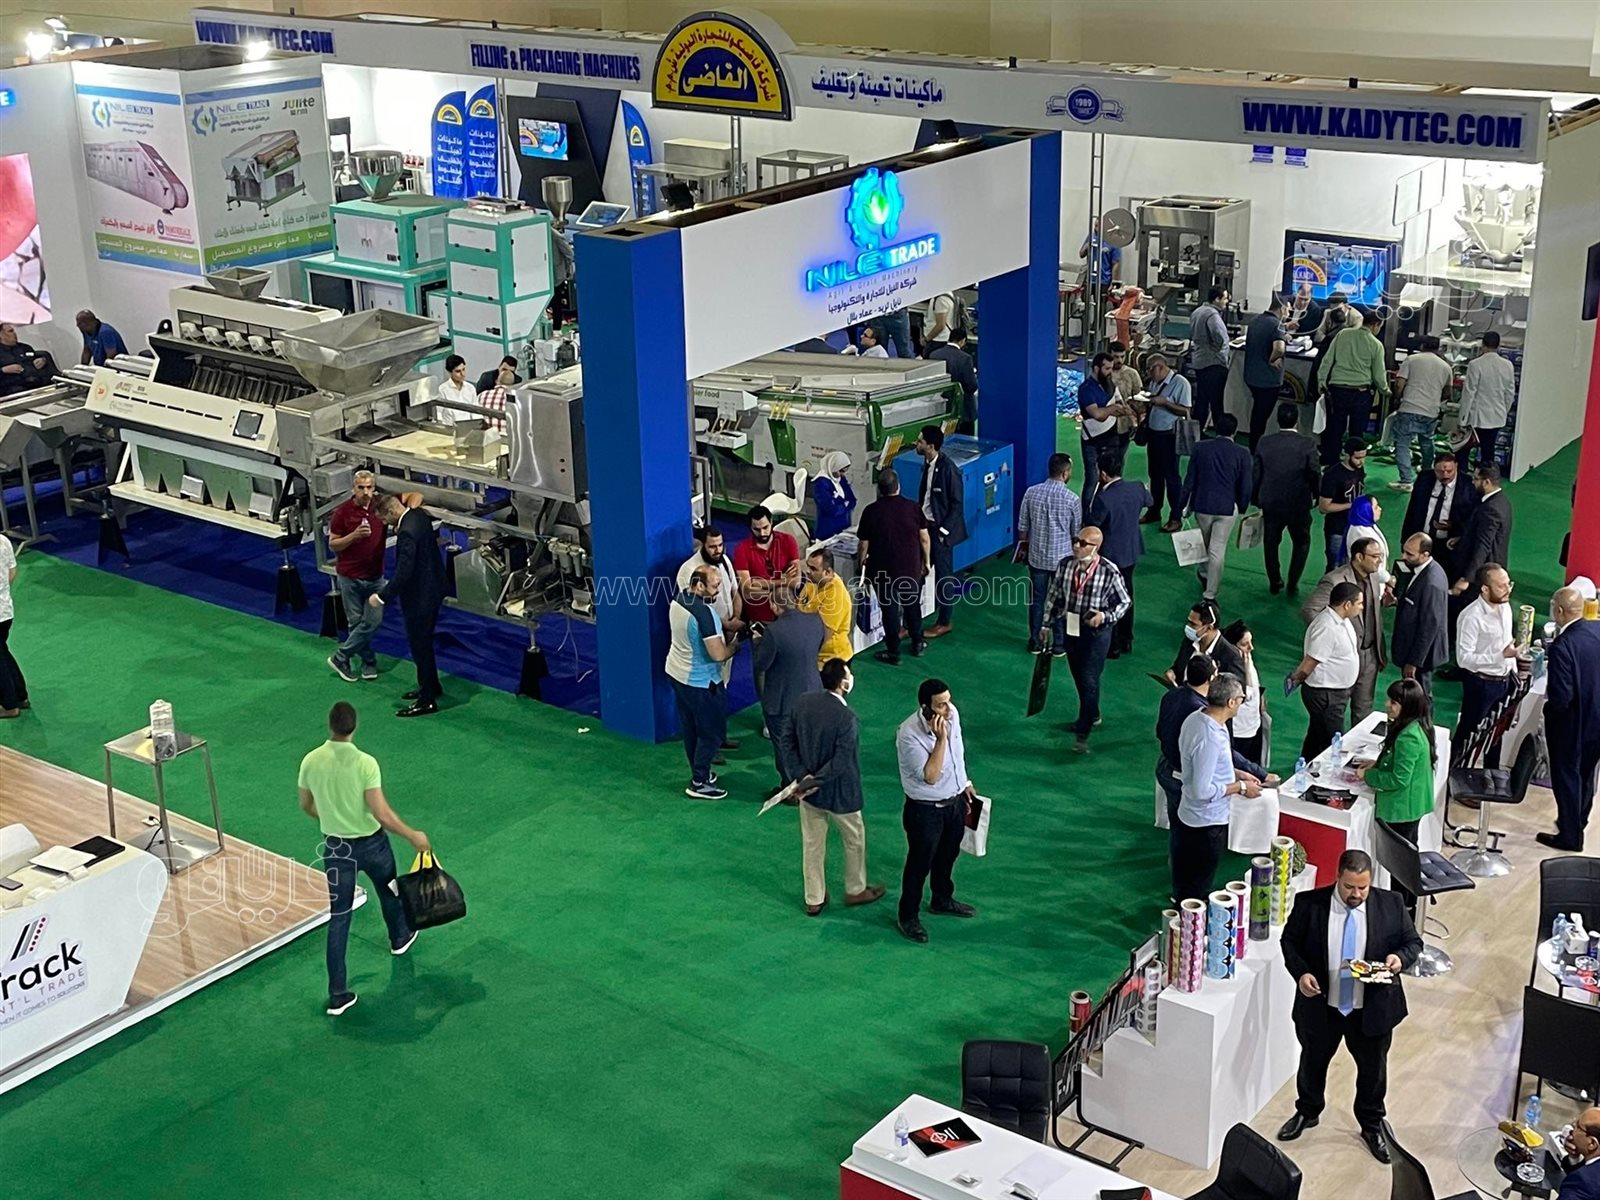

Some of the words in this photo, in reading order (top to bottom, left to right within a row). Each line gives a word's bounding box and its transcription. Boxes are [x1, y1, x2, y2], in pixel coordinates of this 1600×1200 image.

[696, 28, 731, 44] للتجارة
[470, 44, 509, 69] FILLING
[510, 50, 518, 71] &
[519, 48, 581, 76] PACKAGING
[583, 53, 641, 81] MACHINES
[757, 69, 777, 101] شركة
[811, 69, 856, 99] وتغليف
[858, 72, 891, 102] تعبئة
[894, 77, 943, 108] ماكينات
[216, 102, 247, 114] NILE
[1242, 102, 1523, 148] WWW.KADYTEC.COM
[806, 250, 881, 292] NILE
[889, 237, 936, 267] TRADE
[0, 942, 82, 1001] rack
[39, 967, 85, 996] TRADE
